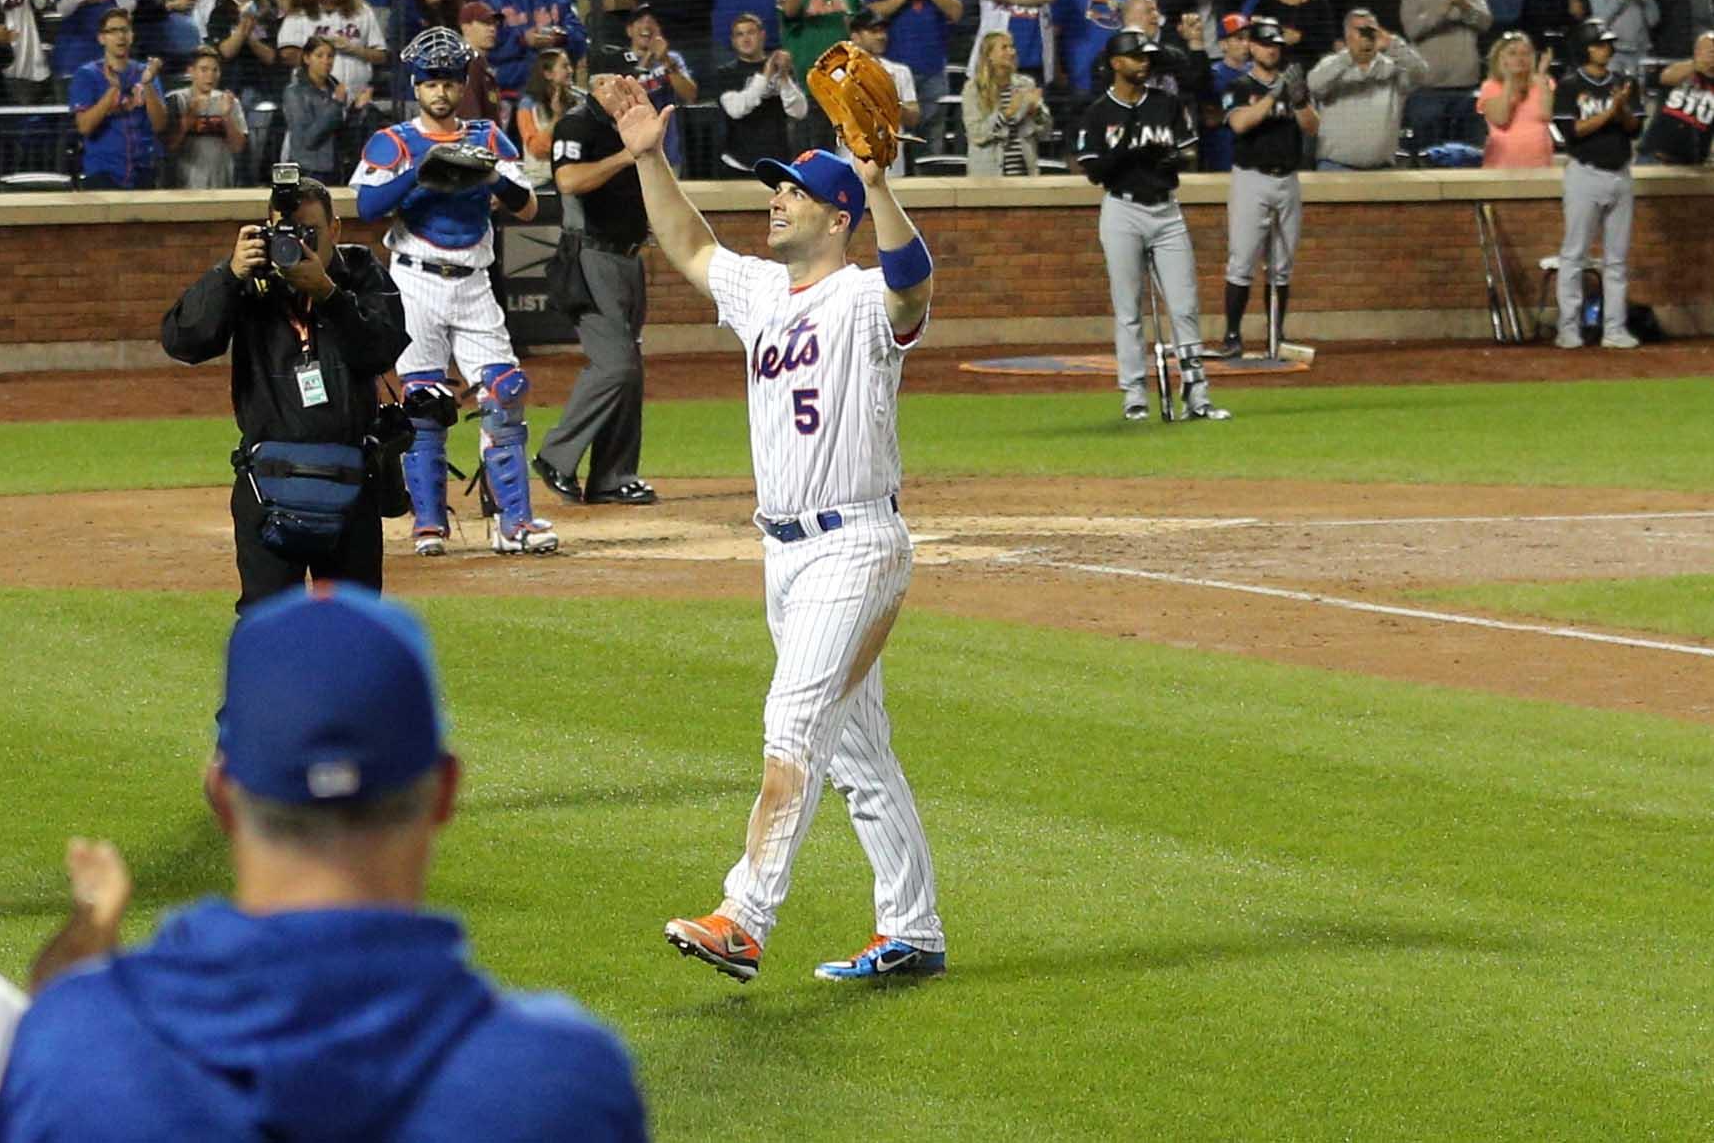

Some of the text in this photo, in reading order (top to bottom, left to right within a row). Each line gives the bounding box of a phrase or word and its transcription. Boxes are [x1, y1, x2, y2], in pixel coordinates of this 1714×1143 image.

[552, 139, 582, 162] 95
[507, 294, 549, 312] LIST
[791, 388, 821, 436] 5
